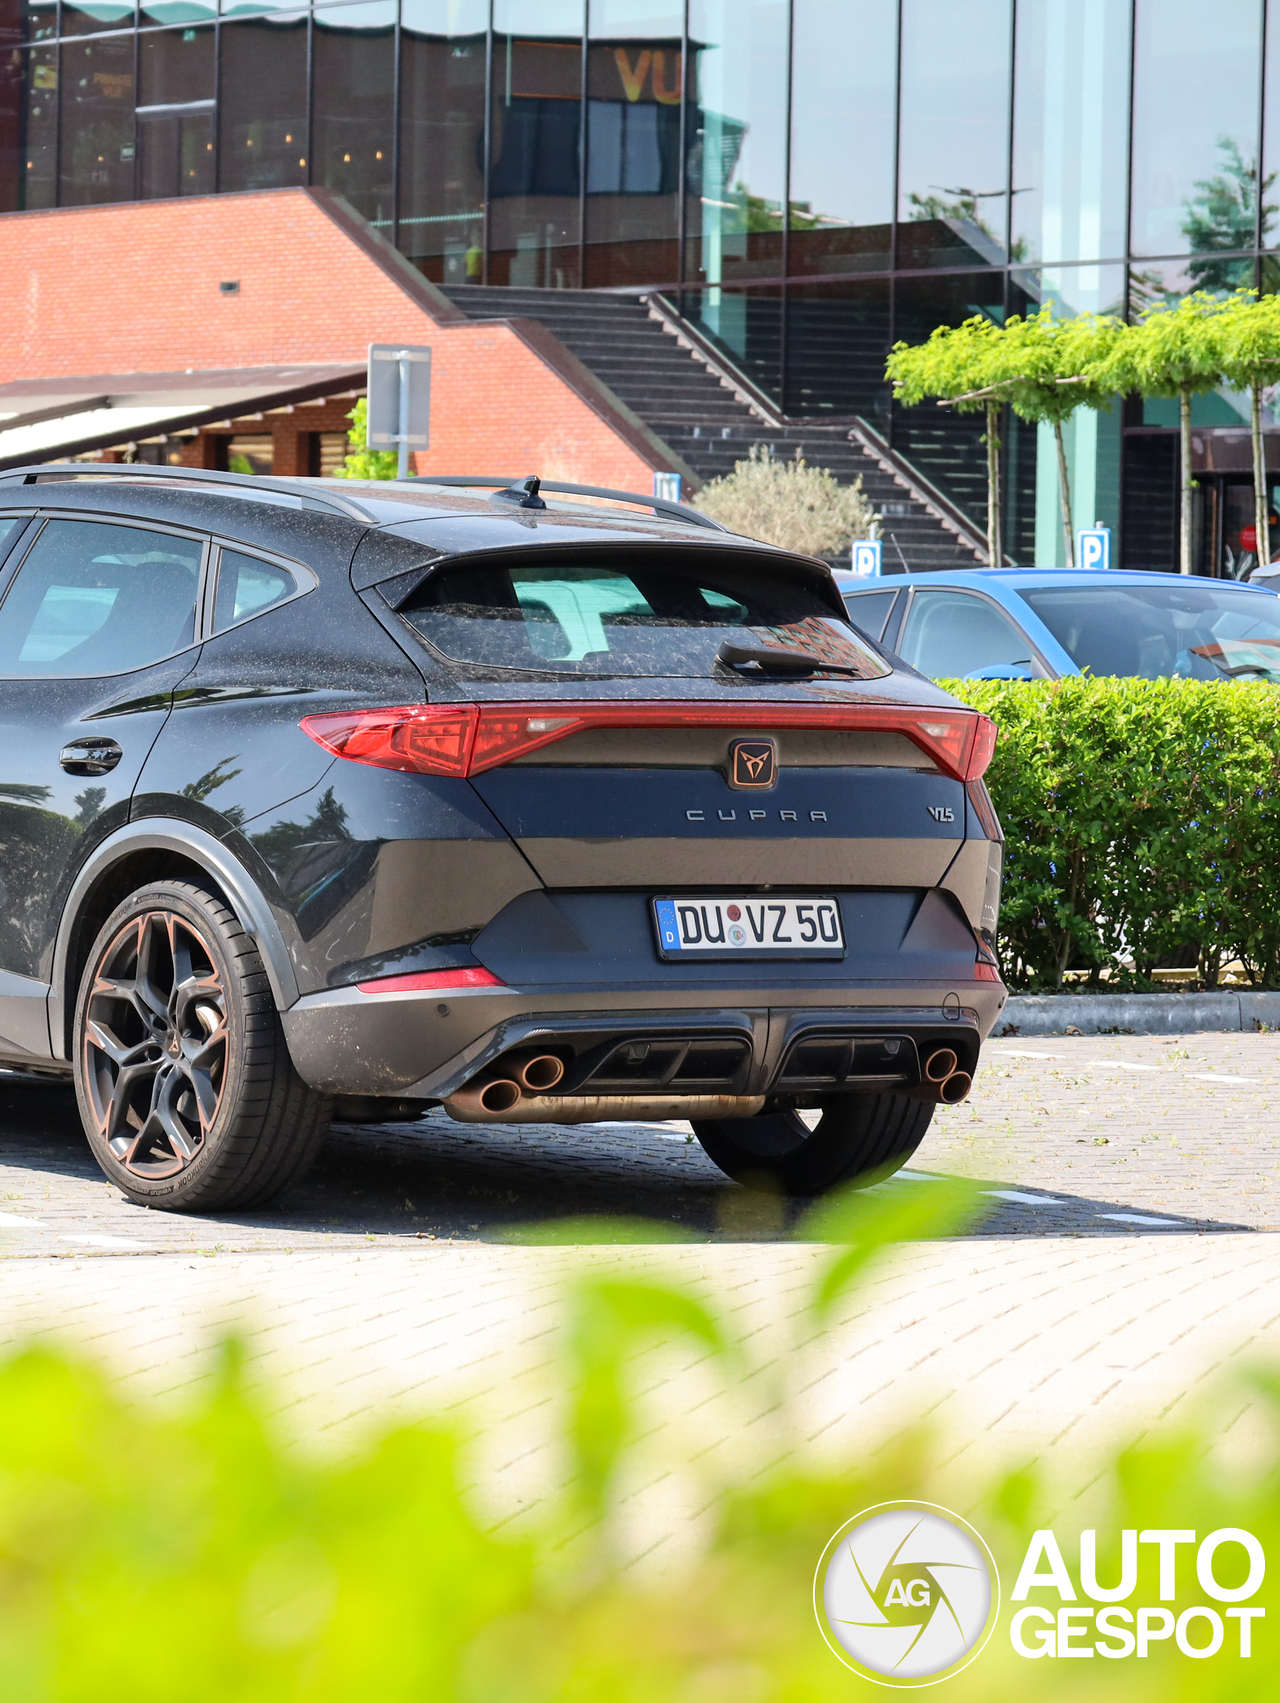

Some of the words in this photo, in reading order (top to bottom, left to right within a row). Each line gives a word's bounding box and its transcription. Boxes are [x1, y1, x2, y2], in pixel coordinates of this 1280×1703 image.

[858, 548, 874, 576] P
[1083, 536, 1102, 569] P
[686, 808, 828, 822] CUPRA
[927, 806, 954, 822] VZ5
[666, 931, 674, 943] D
[677, 905, 726, 943] DU
[746, 904, 792, 943] VZ
[796, 905, 839, 943] 50
